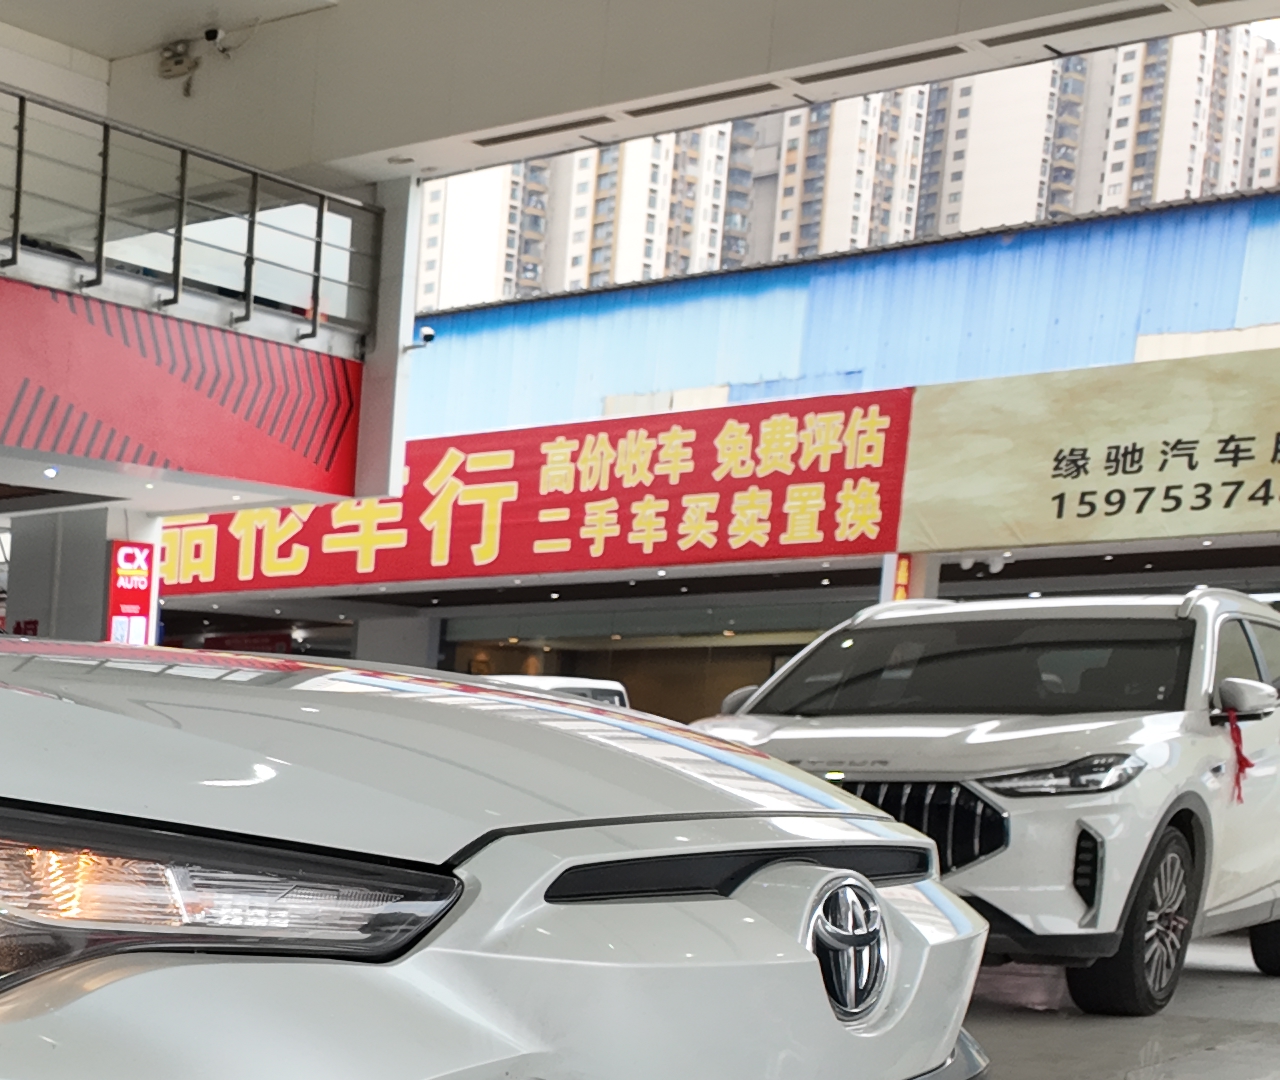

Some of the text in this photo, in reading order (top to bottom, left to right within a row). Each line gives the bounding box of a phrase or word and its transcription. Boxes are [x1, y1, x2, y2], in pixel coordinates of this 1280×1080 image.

[538, 404, 891, 496] 高价收车 免费评估
[1050, 431, 1280, 480] 缘驰汽车
[532, 476, 883, 558] 二手车买卖置换
[116, 545, 150, 570] CX
[116, 575, 149, 590] AUTO
